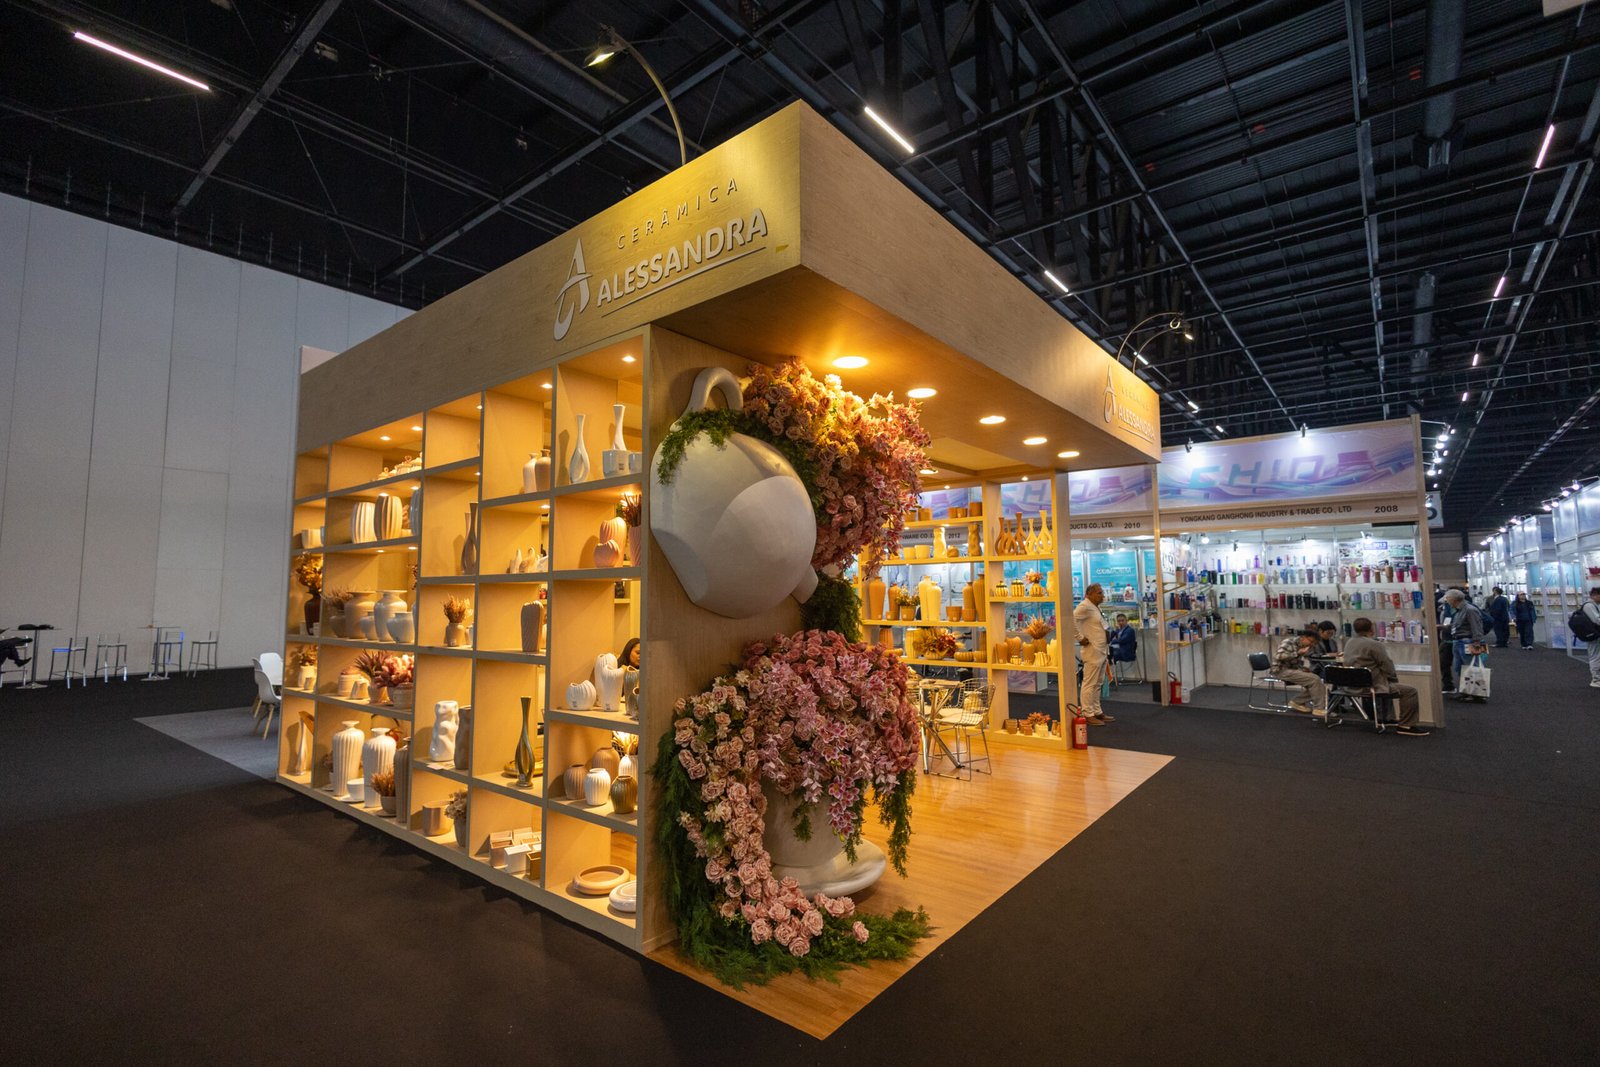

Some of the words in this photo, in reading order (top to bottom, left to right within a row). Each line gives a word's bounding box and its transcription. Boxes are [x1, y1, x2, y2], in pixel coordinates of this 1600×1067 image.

[616, 177, 738, 250] CERÂMICA
[596, 207, 769, 308] ALESSANDRA
[1180, 513, 1216, 523] YONGKANG
[1255, 509, 1288, 518] INDUSTRY
[1296, 507, 1321, 516] TRADE
[1374, 504, 1399, 514] 2008
[1123, 521, 1141, 529] 2010
[948, 532, 961, 540] 2012
